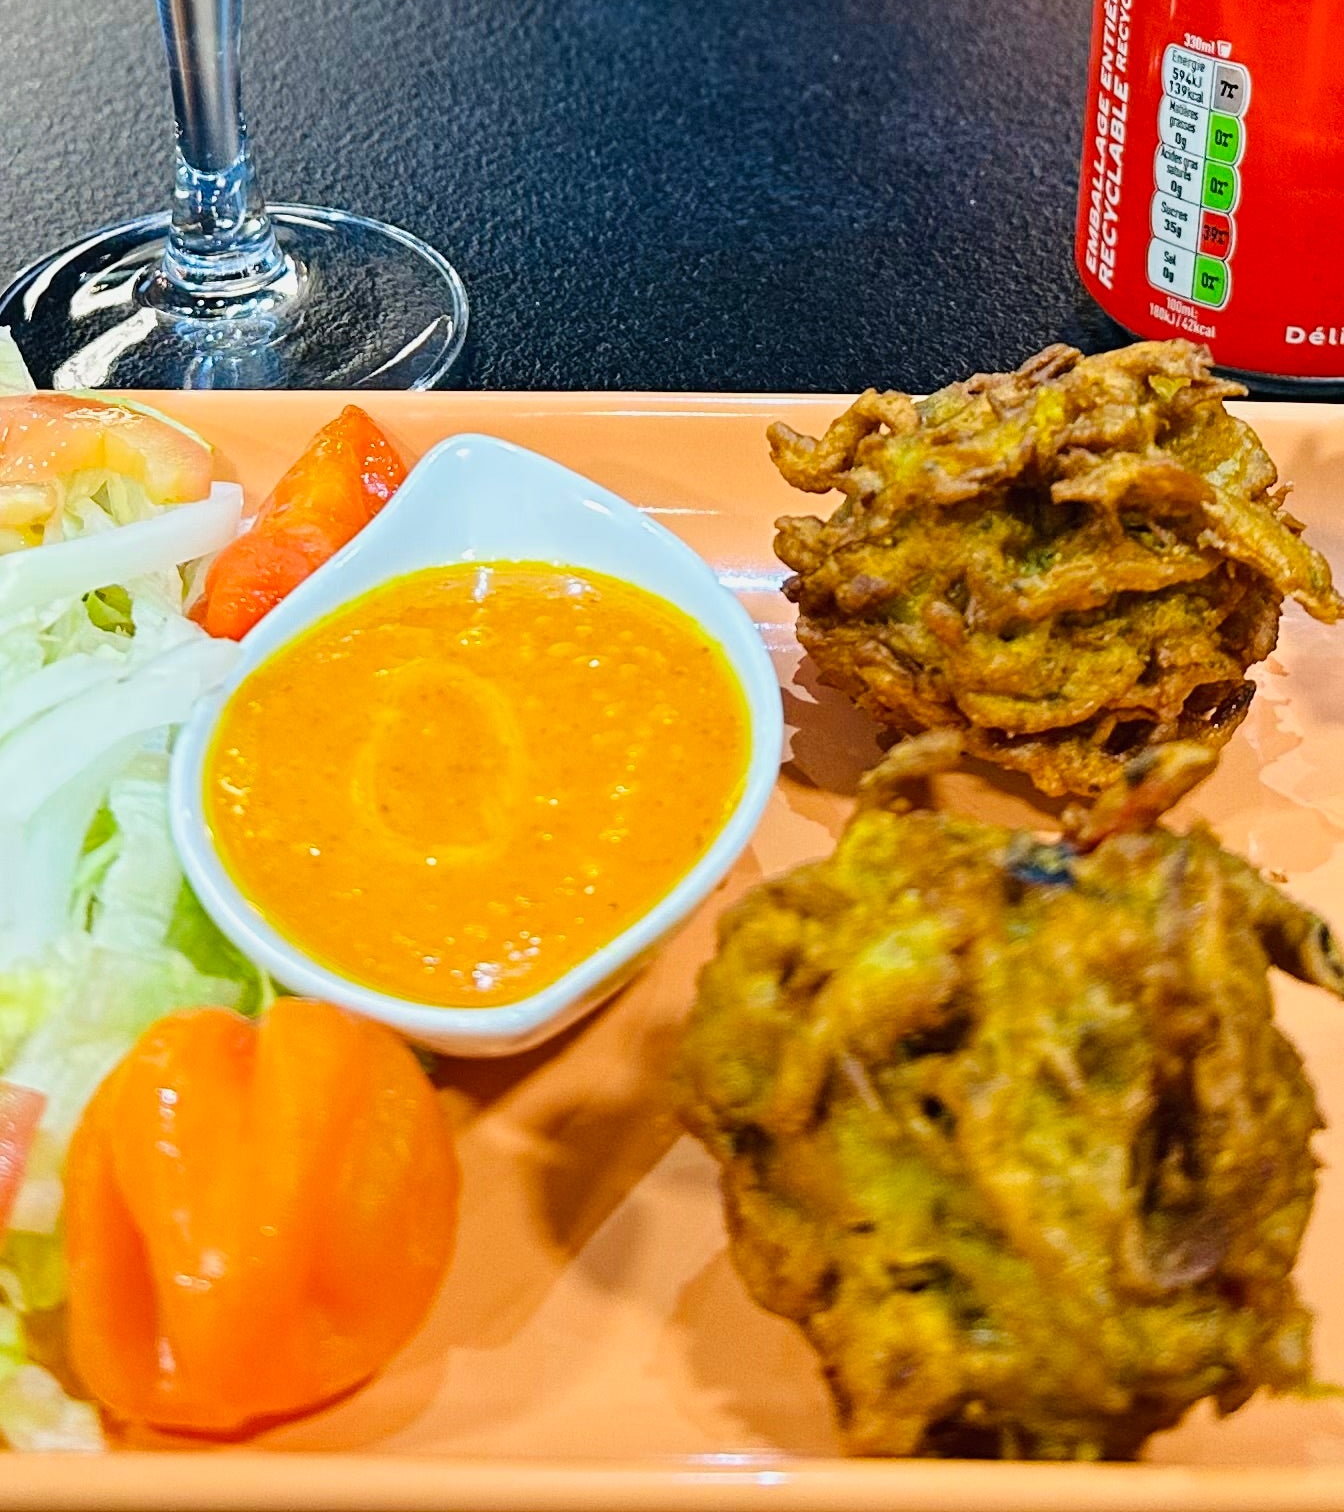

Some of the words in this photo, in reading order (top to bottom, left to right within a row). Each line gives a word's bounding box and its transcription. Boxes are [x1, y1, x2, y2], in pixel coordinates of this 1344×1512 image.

[1085, 91, 1110, 274] EMBALLAGE
[1098, 74, 1129, 289] RECYCLABLE
[1164, 219, 1182, 238] 35g
